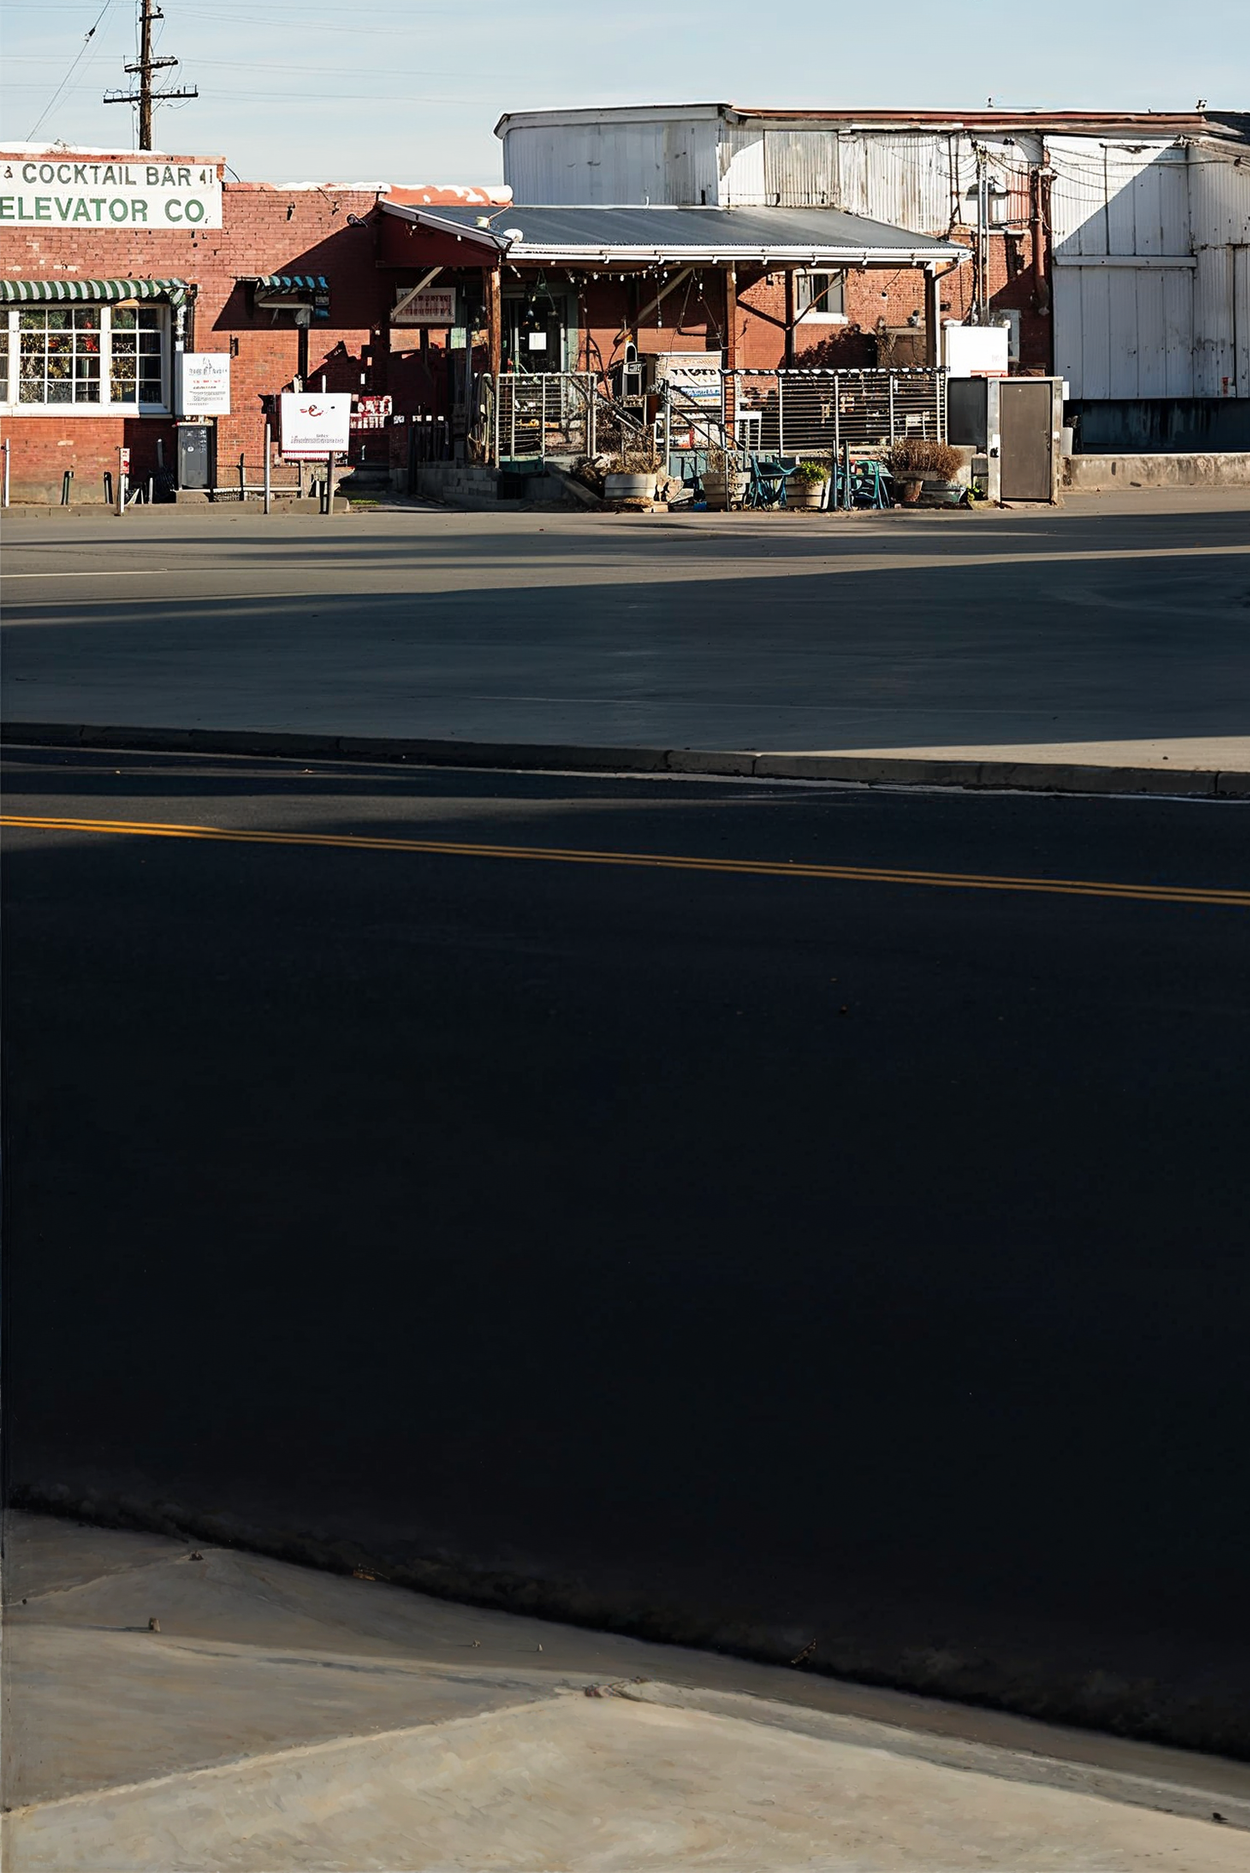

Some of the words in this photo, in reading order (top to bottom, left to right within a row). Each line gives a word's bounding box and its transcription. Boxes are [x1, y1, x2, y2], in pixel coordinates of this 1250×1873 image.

[22, 163, 137, 185] COCKTAIL
[146, 165, 192, 186] BAR
[0, 196, 148, 222] ELEVATOR
